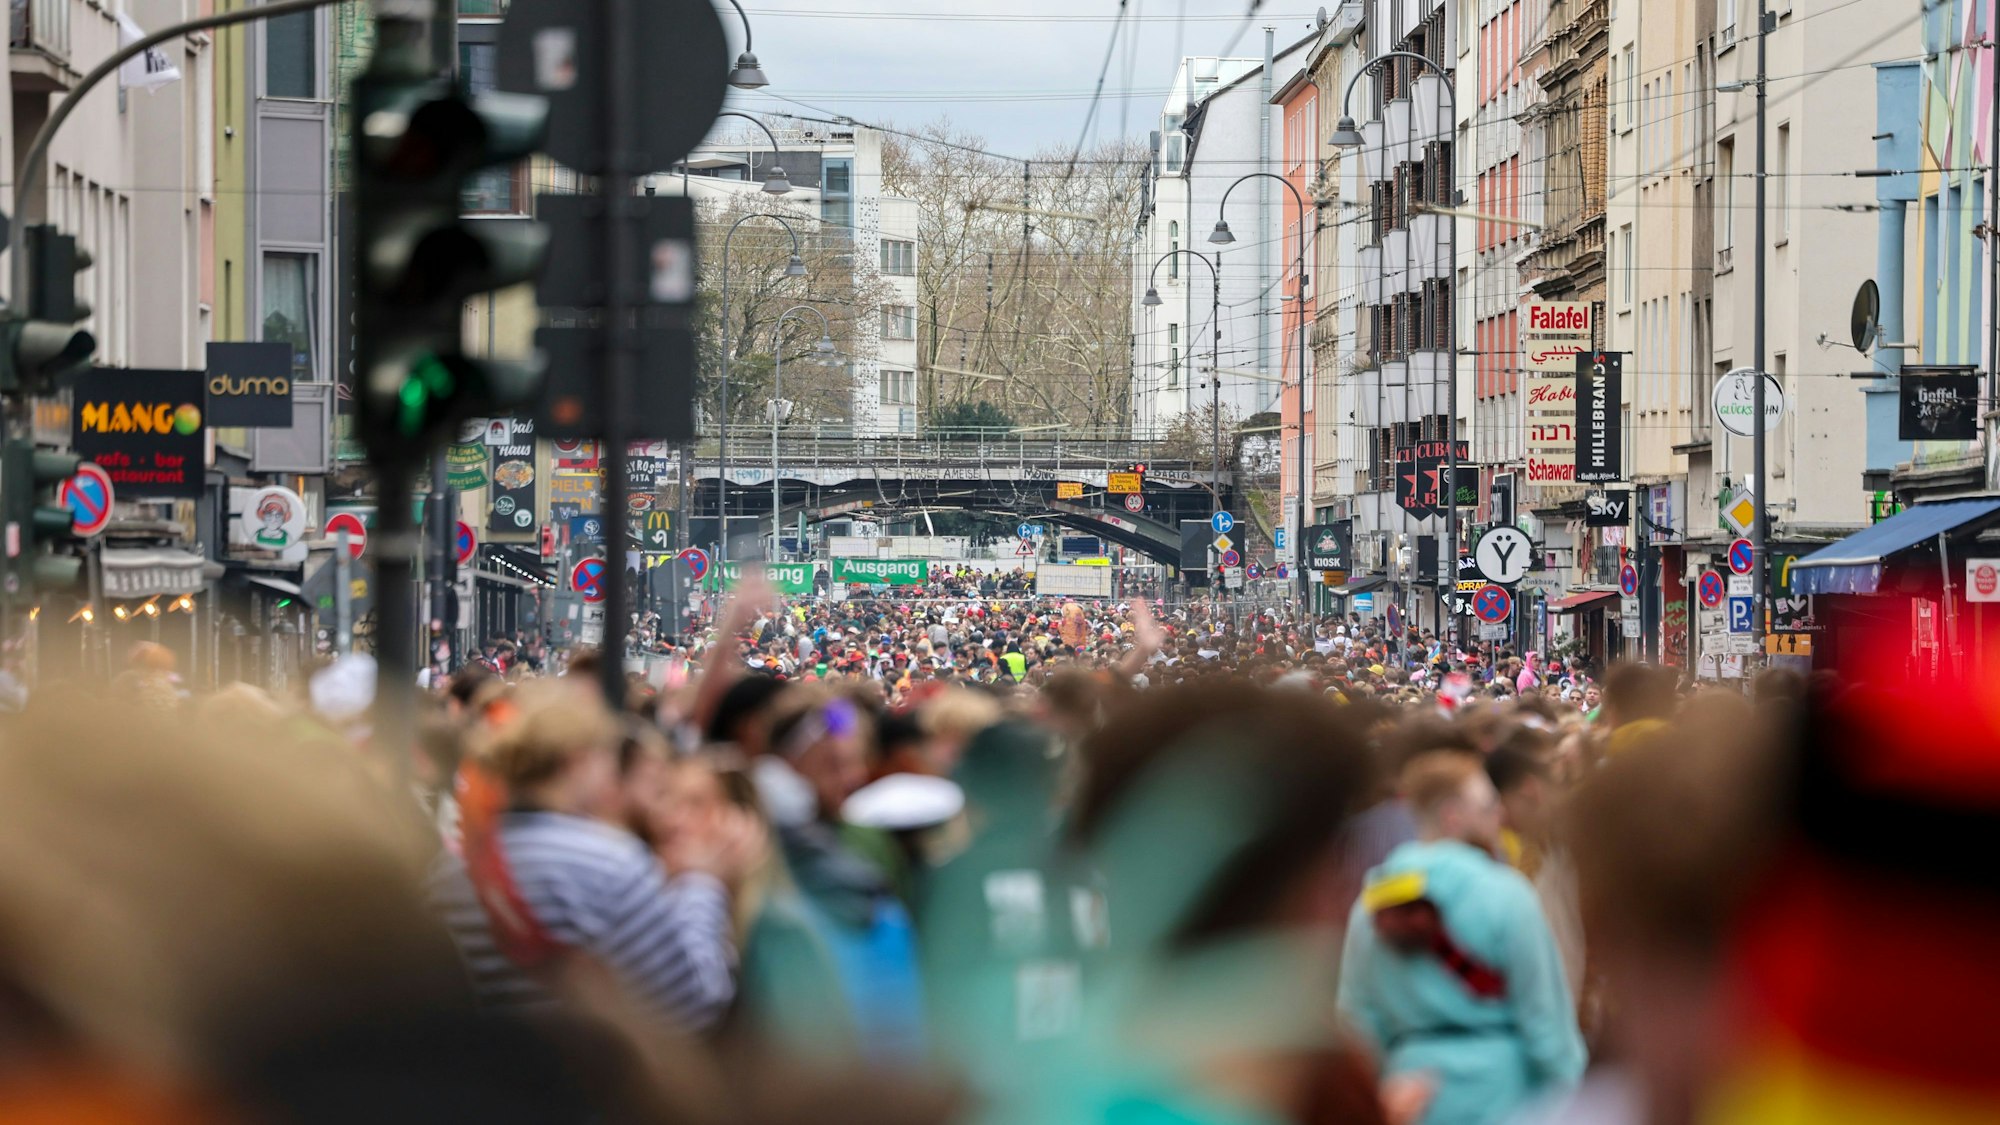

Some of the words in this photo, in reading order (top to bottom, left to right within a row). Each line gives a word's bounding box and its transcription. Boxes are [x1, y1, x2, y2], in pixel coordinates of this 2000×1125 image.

[1530, 306, 1588, 329] Falafel
[209, 373, 289, 396] duma
[1529, 384, 1576, 405] Habi
[1720, 402, 1779, 416] GLÜCKSHN
[511, 418, 534, 434] bab
[1532, 424, 1576, 441] רכה
[155, 451, 184, 468] bar
[106, 469, 185, 483] staurant
[630, 474, 650, 482] PITA
[1529, 458, 1576, 481] Schawar
[551, 480, 582, 493] PIEL
[1591, 501, 1624, 519] sky
[842, 559, 920, 579] Ausgang
[1314, 558, 1341, 567] KIOSK
[714, 565, 805, 585] Auang
[1457, 582, 1488, 591] APRAK
[1732, 600, 1747, 629] P
